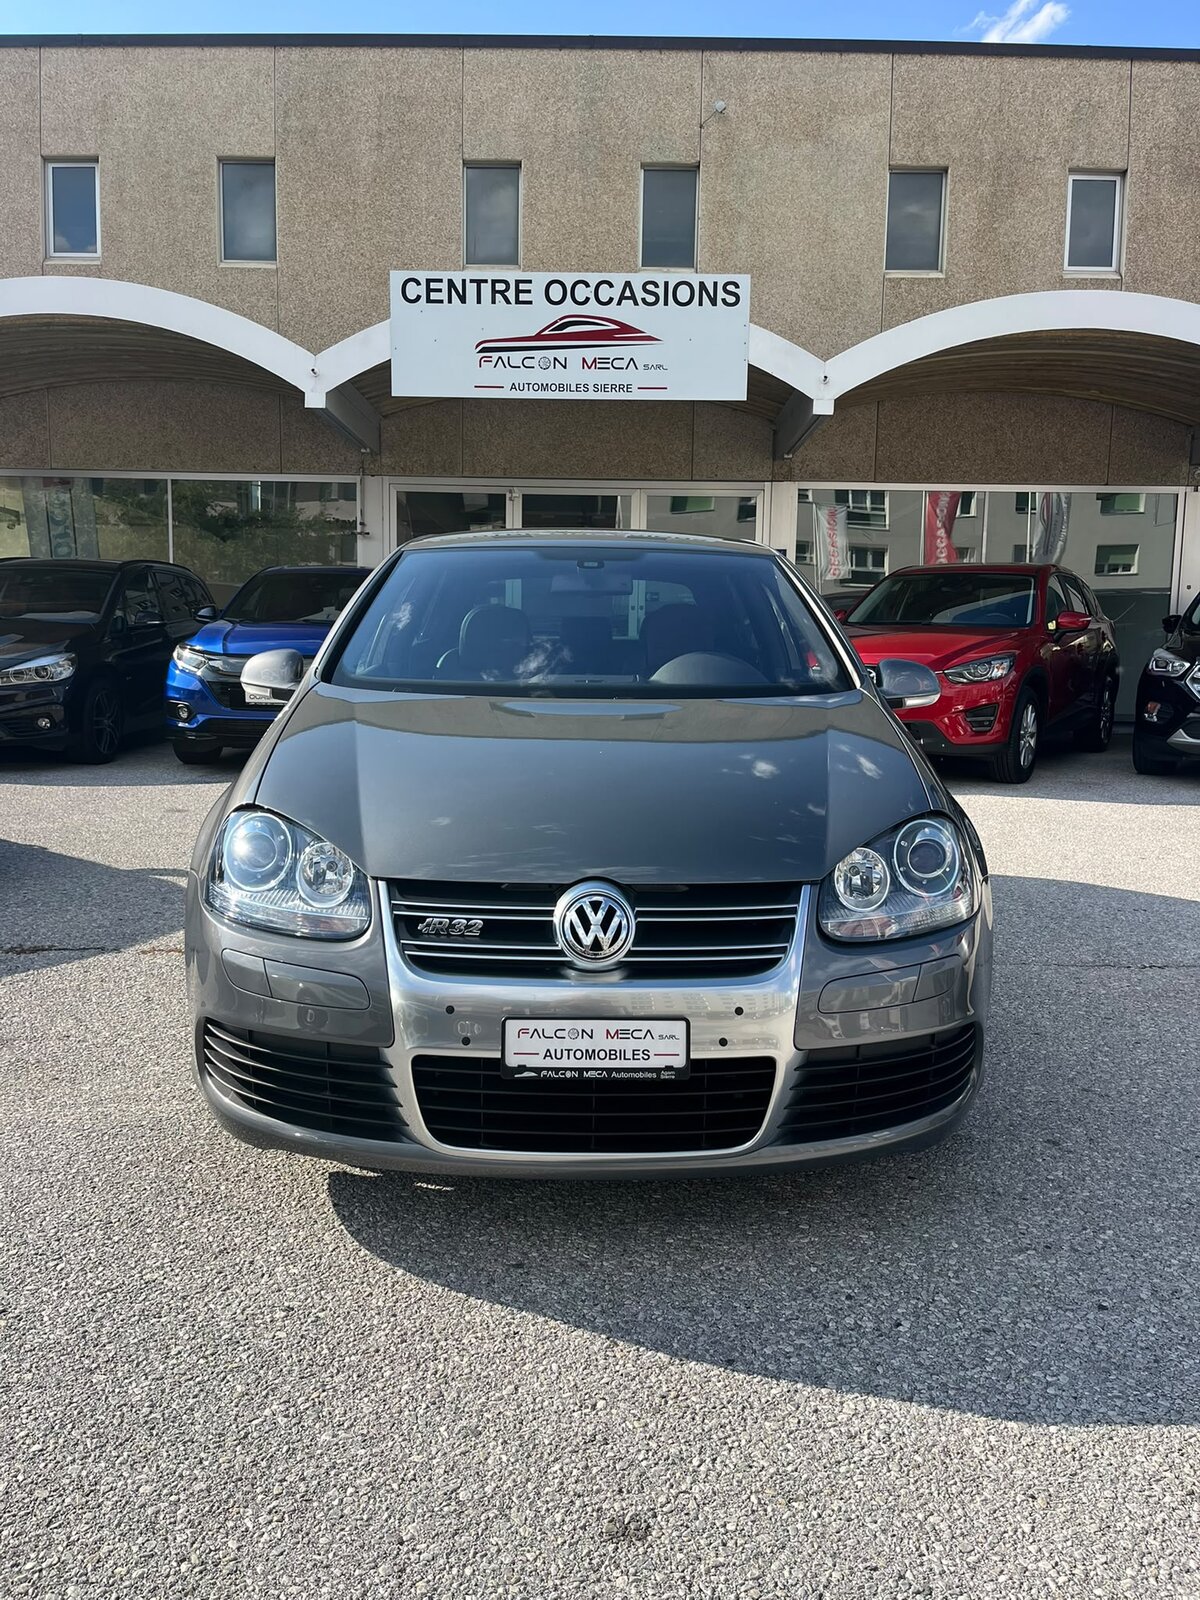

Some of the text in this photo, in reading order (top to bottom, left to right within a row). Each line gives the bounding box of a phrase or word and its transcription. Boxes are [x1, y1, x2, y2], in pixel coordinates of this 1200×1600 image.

[400, 277, 742, 307] CENTRE OCCASIONS
[478, 356, 669, 372] FALCON MECA SARL
[509, 382, 633, 393] AUTOMOBILES SIERRE
[517, 1028, 594, 1040] FALCON
[605, 1029, 655, 1040] MECA
[543, 1048, 651, 1061] AUTOMOBILES
[540, 1070, 579, 1078] FALCON
[583, 1070, 608, 1078] MECA
[611, 1071, 657, 1079] Automobiles
